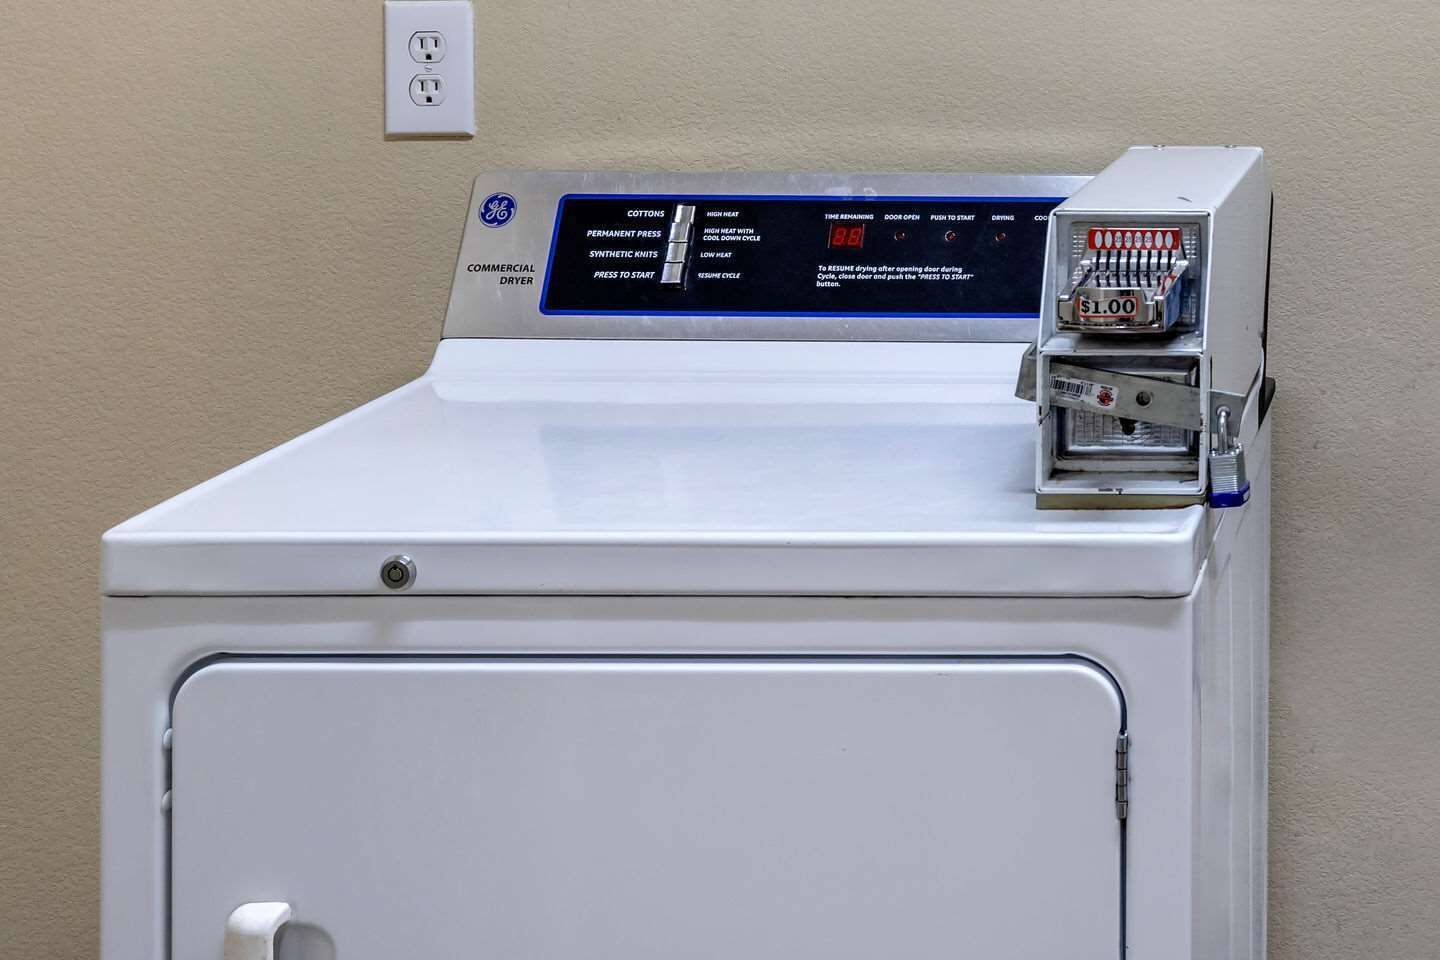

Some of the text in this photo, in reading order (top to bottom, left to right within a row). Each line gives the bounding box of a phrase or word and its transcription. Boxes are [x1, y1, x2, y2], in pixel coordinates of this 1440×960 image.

[627, 209, 665, 218] COTTONS
[587, 229, 662, 238] PERMANENT PRESS
[589, 250, 658, 259] SYNTHETIC KNITS
[467, 263, 536, 273] COMMERCIAL
[818, 265, 963, 273] To RESUME drying after opening door during
[594, 270, 655, 279] PRESS TO START
[500, 276, 534, 285] DRYER
[1081, 298, 1136, 315] $1.00
